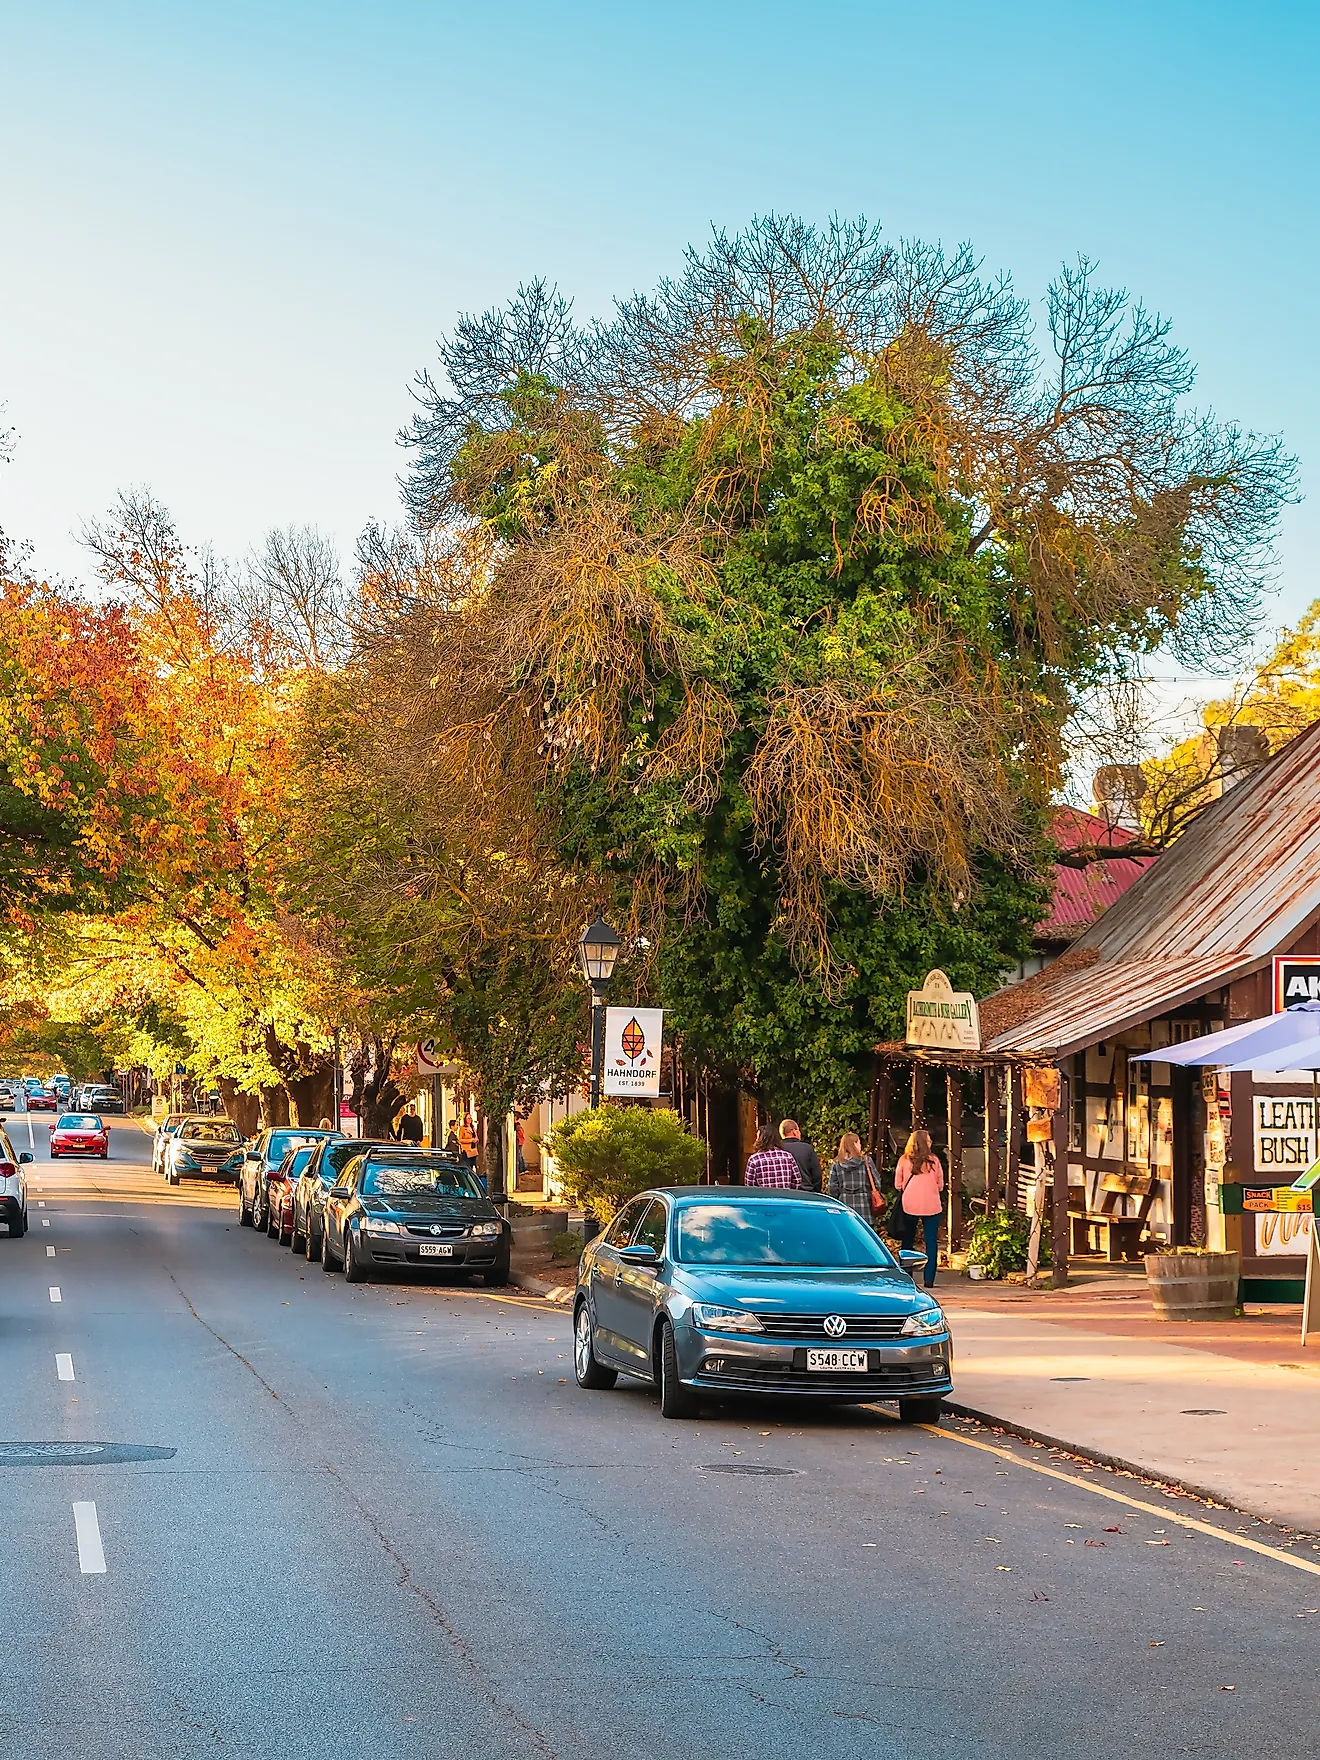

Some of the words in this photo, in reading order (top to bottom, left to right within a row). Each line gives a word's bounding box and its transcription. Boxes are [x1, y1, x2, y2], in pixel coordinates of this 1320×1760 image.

[607, 1069, 656, 1078] HAHNDORF
[1260, 1137, 1309, 1163] BUSH
[1246, 1191, 1271, 1199] SNACK
